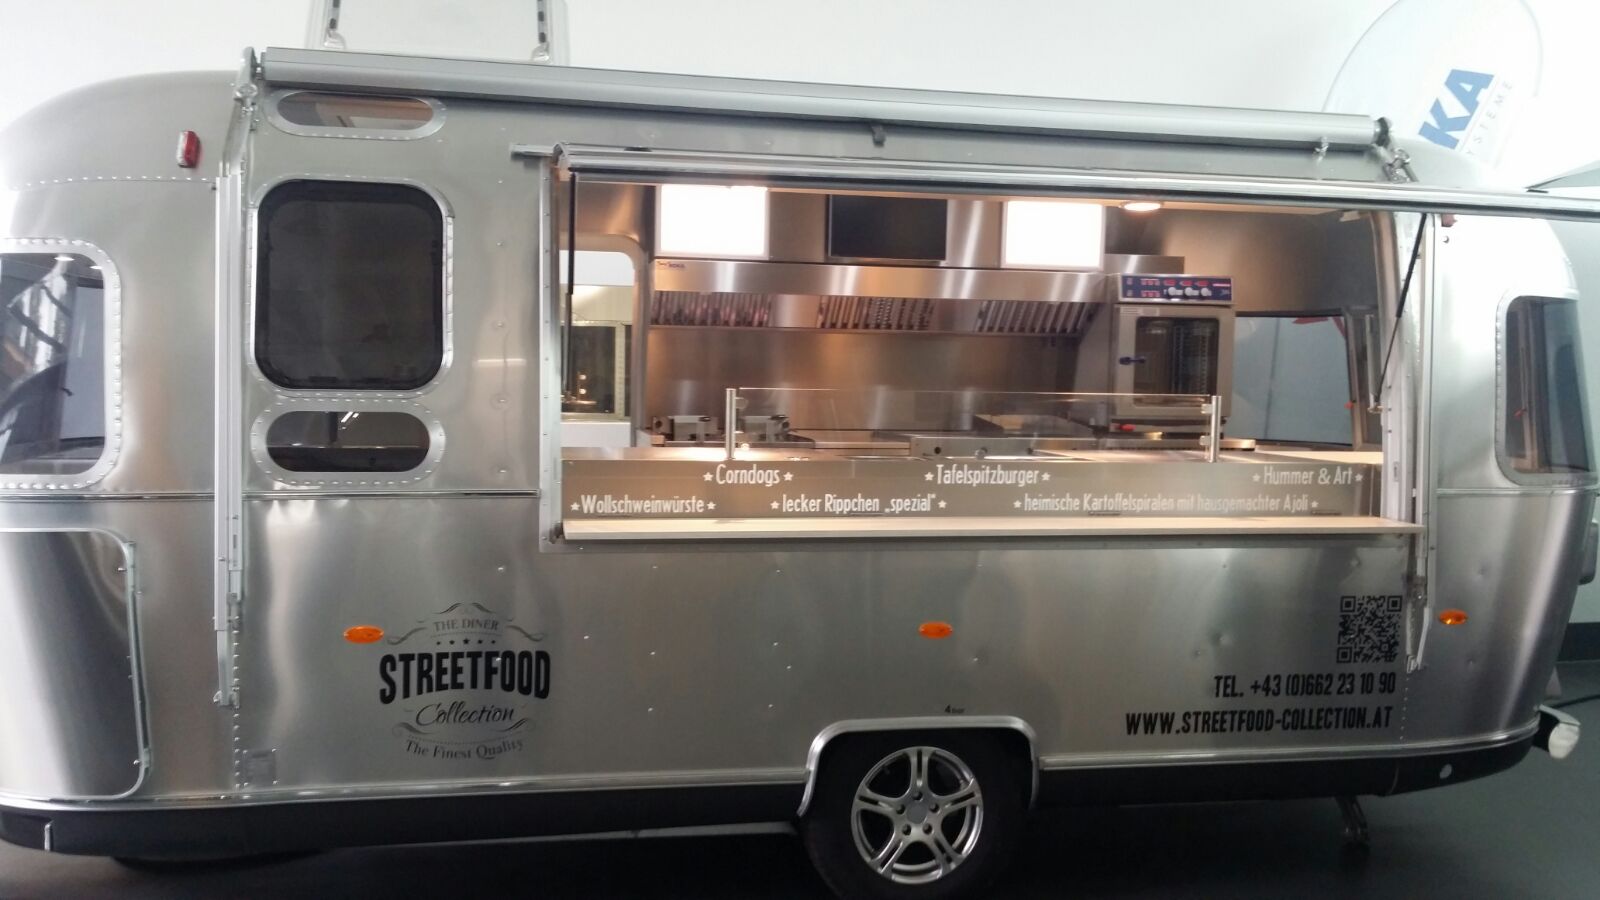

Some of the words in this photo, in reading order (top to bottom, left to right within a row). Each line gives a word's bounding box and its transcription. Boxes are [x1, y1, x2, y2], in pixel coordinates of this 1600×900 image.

[716, 463, 780, 487] Corndogs
[936, 463, 1040, 487] Tafelspitzburger
[1263, 465, 1314, 485] Hummer
[1317, 467, 1332, 485] &
[1332, 465, 1353, 485] Art
[580, 494, 705, 514] Wollschweinwürste
[782, 493, 822, 512] lecker
[824, 493, 880, 514] Rippchen
[1023, 493, 1080, 511] heimische
[1083, 493, 1174, 513] Kartoffelspiralen
[1177, 493, 1194, 511] mit
[1197, 494, 1280, 514] hausgemachter
[433, 620, 457, 633] THE
[461, 618, 500, 631] DINER
[378, 650, 551, 704] STREETFOOD
[1214, 675, 1244, 698] TEL.
[1250, 674, 1282, 697] +43
[1286, 673, 1333, 696] (0)662
[1336, 672, 1356, 695] 23
[1360, 672, 1374, 694] 10
[1378, 671, 1397, 694] 90
[415, 701, 514, 726] Collection
[1125, 706, 1393, 735] WWW.STREETFOOD-COLLECTION.AT
[406, 740, 429, 756] The
[433, 745, 472, 759] Finest
[476, 740, 524, 760] Quality
